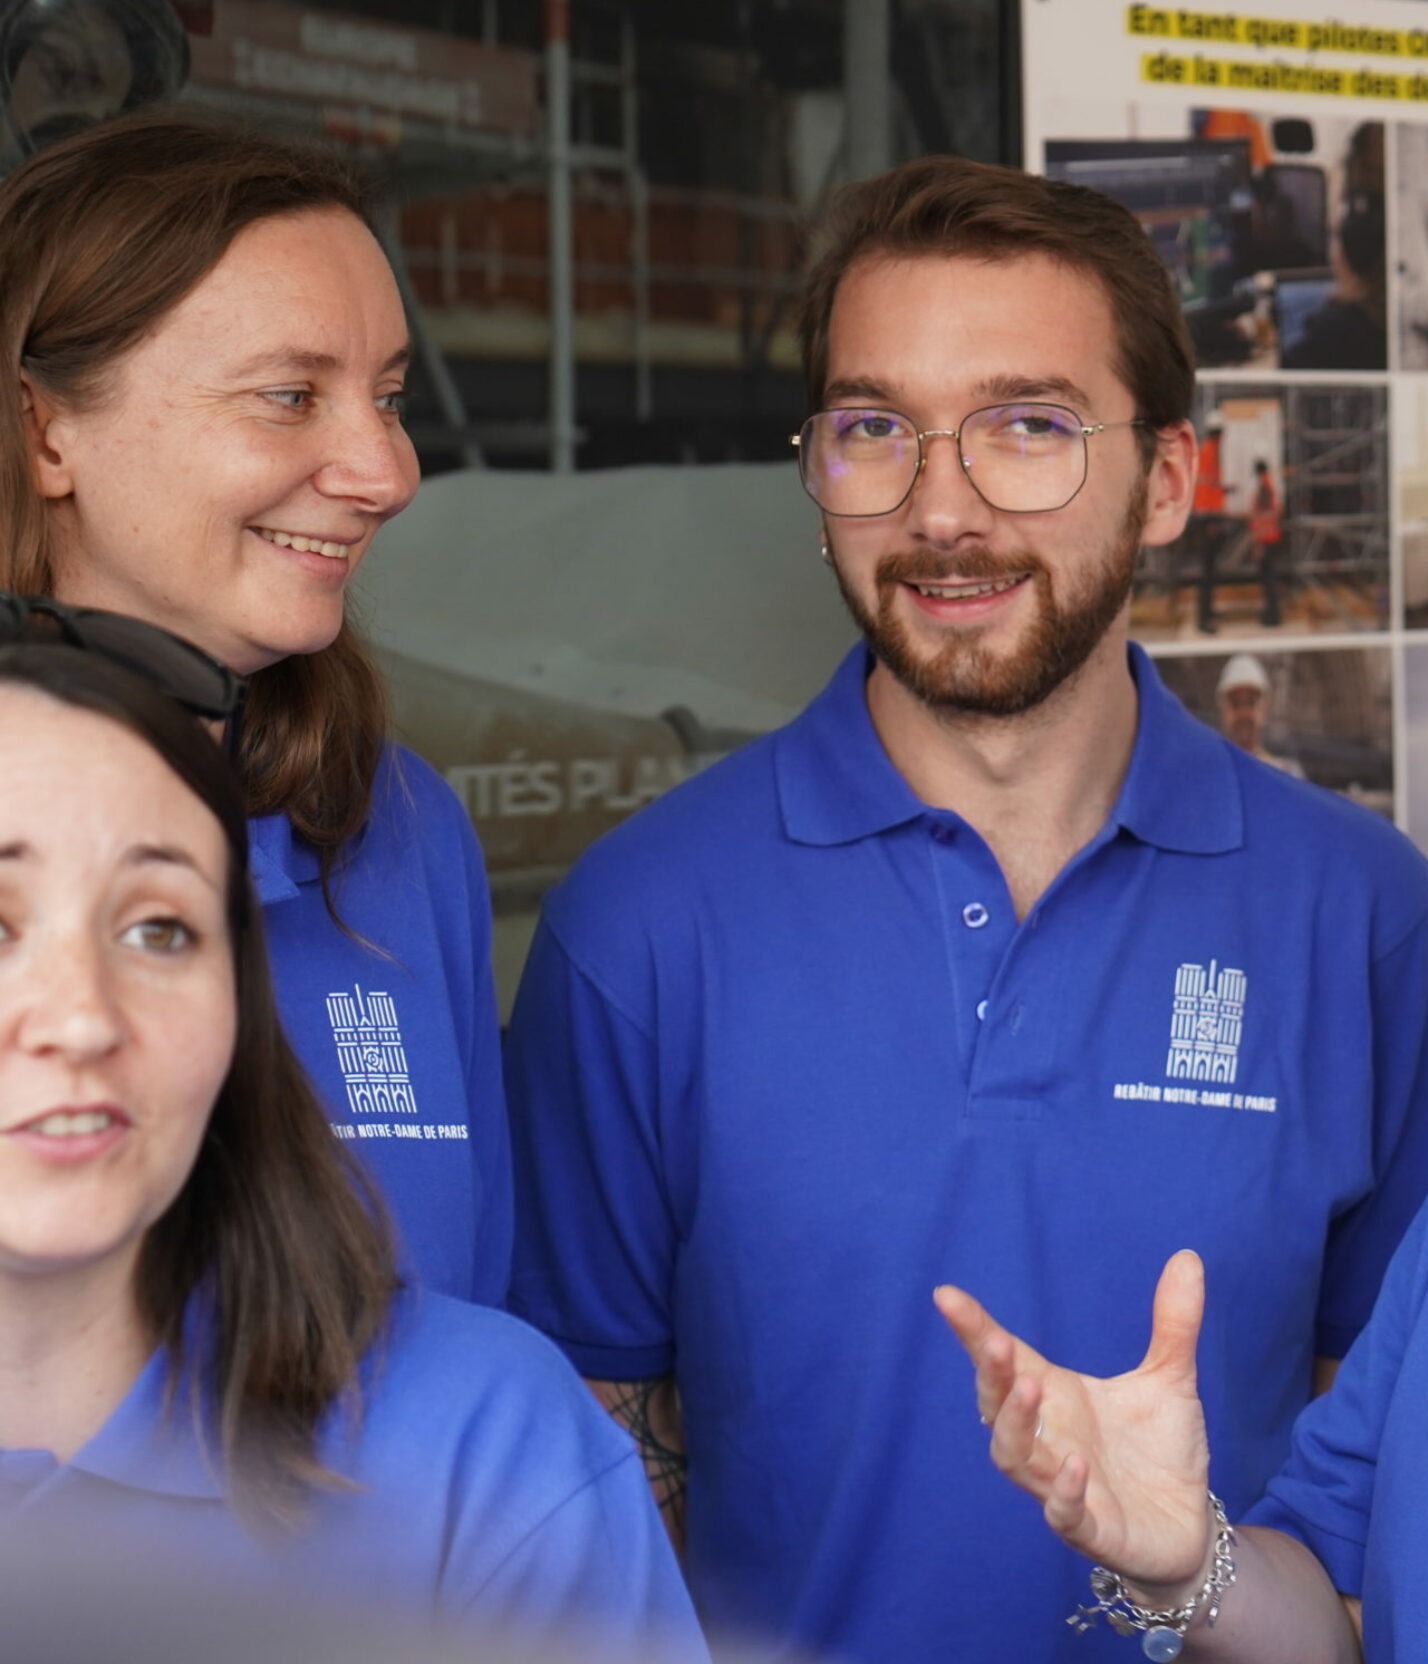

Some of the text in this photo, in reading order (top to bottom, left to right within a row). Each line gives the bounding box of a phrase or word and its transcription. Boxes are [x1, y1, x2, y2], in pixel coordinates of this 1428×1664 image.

[1129, 3, 1166, 34] En
[1178, 9, 1236, 40] tant
[1246, 20, 1298, 50] que
[1309, 18, 1398, 54] pilotes
[1149, 50, 1183, 80] de
[1194, 52, 1218, 82] la
[1229, 58, 1342, 92] maîtrise
[1354, 66, 1397, 96] des
[1114, 1082, 1161, 1101] REBÂTIR
[1163, 1087, 1232, 1108] NOTRE-DAME
[1245, 1095, 1278, 1112] PARIS
[358, 1124, 423, 1139] NOTRE-DAME
[424, 1125, 437, 1140] DE
[438, 1124, 469, 1140] PARIS
